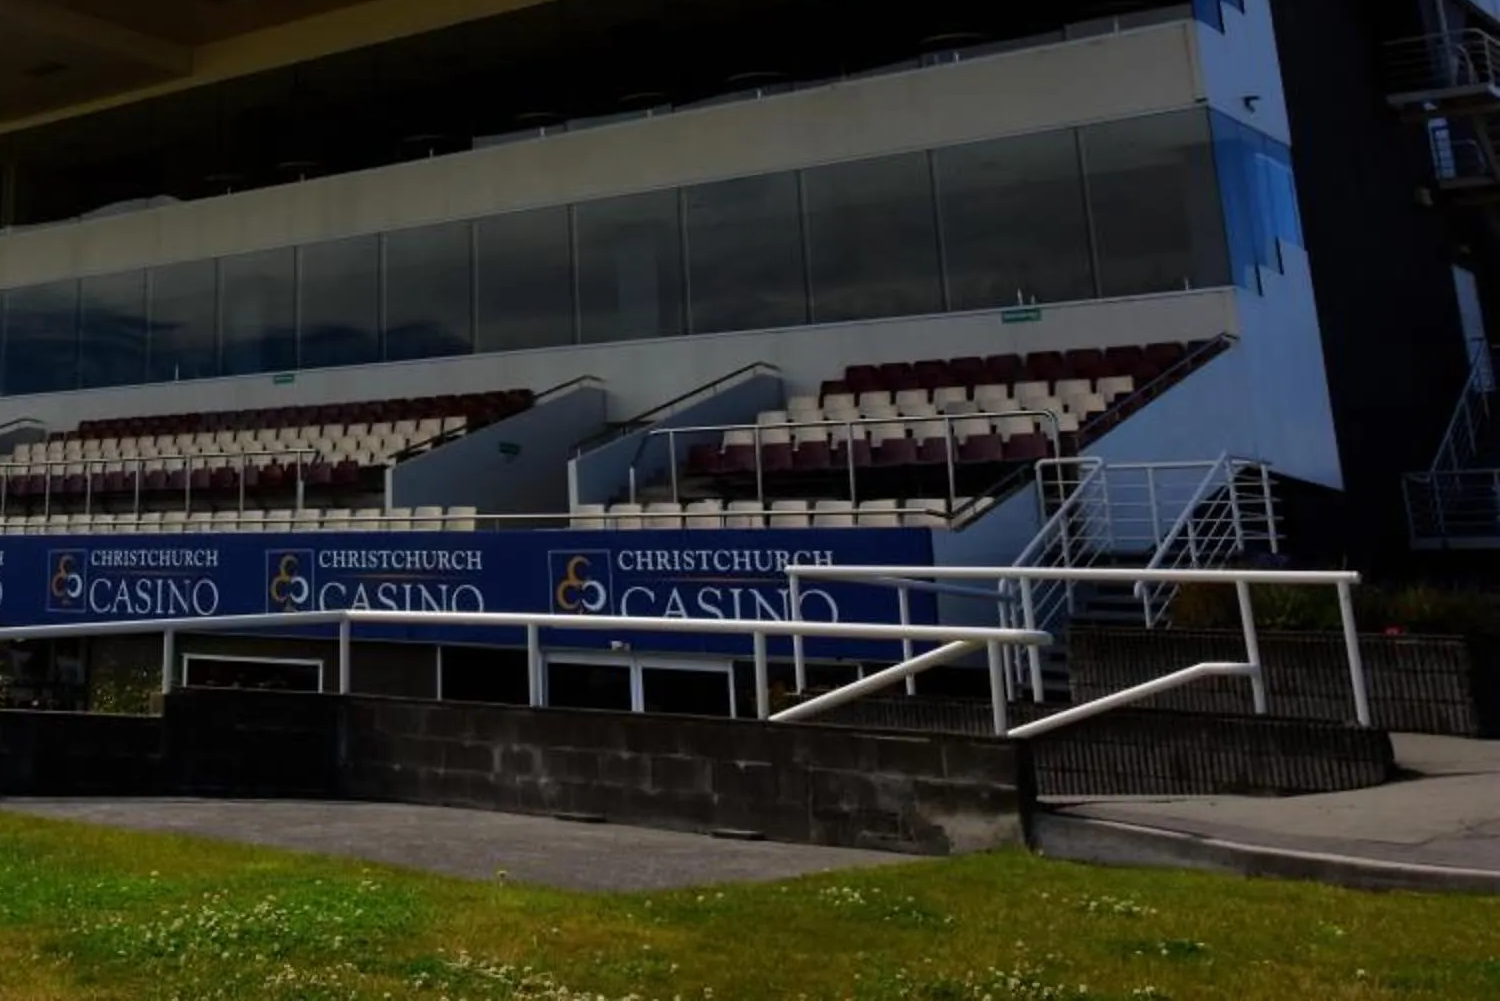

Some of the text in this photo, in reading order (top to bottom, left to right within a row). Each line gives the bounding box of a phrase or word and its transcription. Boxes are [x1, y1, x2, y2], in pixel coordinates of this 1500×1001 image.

[90, 549, 219, 567] CHRISTCHURCH
[318, 550, 483, 570] CHRISTCHURCH
[618, 550, 834, 571] CHRISTCHURCH
[89, 578, 219, 616] CASINO
[318, 582, 485, 613] CASINO
[620, 586, 839, 622] CASINO
